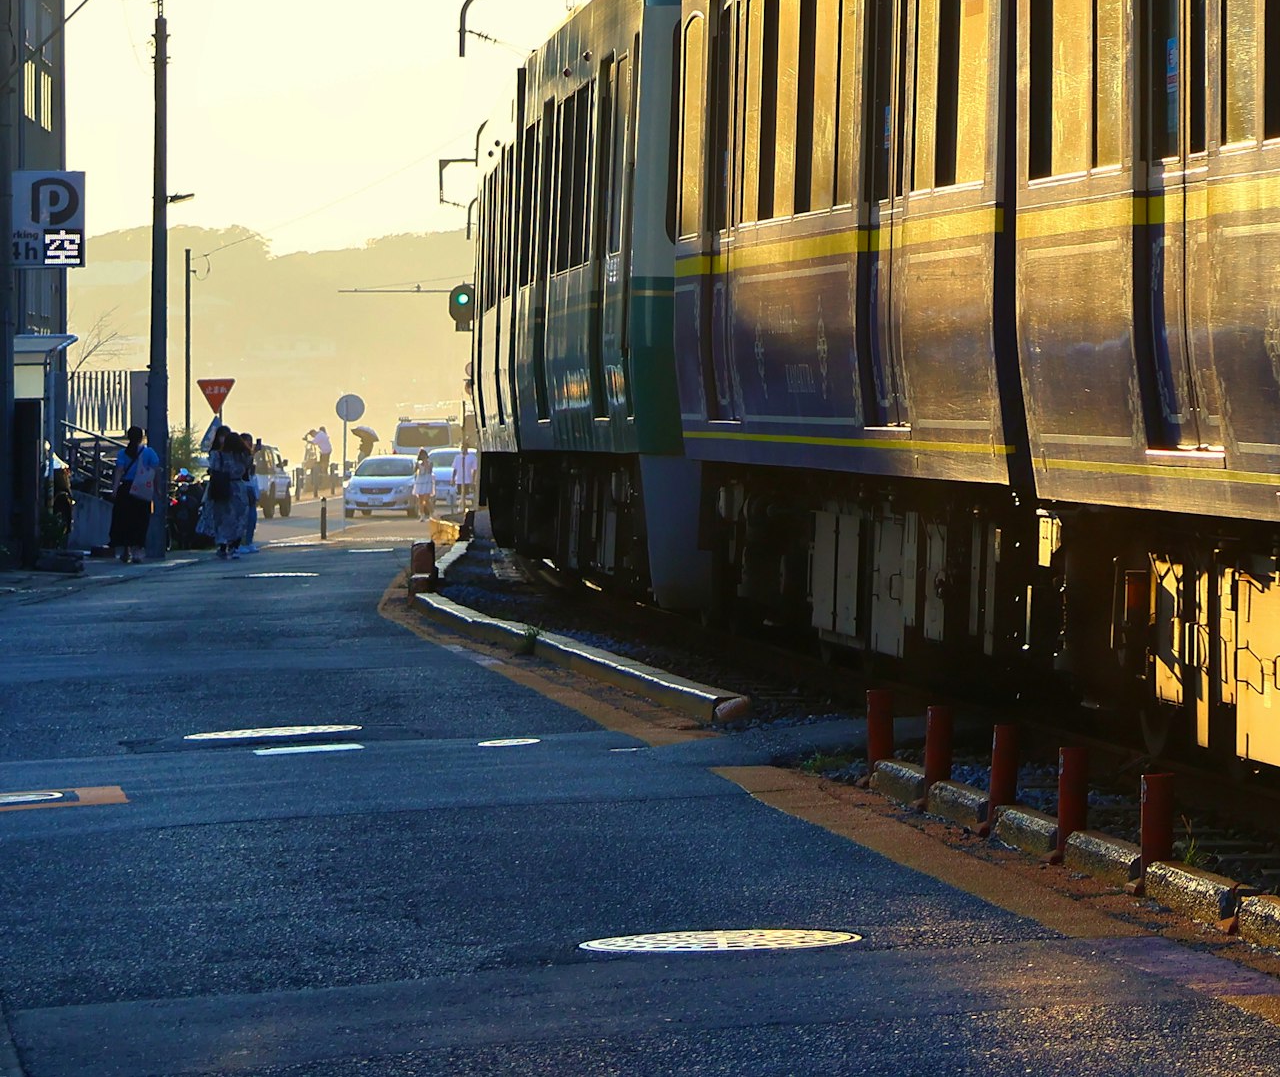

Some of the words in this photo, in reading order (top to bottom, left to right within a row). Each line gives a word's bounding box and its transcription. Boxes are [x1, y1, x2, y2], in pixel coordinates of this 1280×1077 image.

[31, 178, 79, 225] P
[13, 230, 39, 240] rking
[44, 230, 80, 264] 空
[12, 242, 38, 260] 4h
